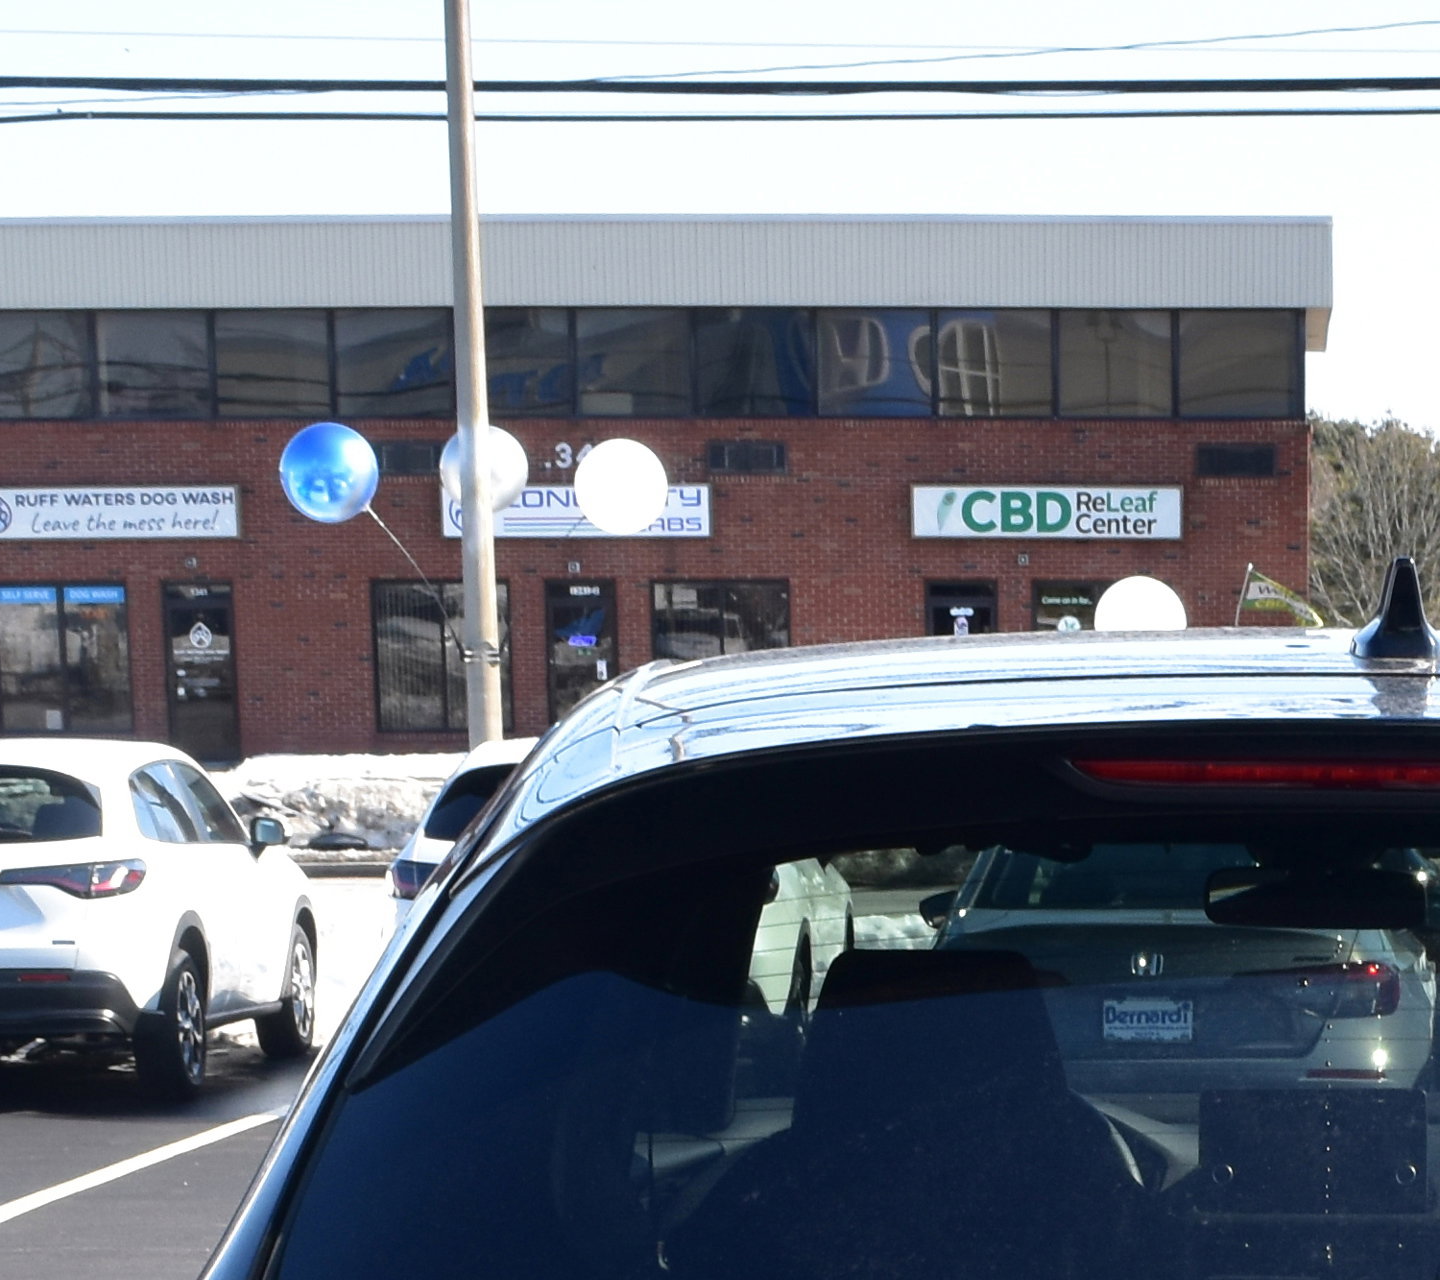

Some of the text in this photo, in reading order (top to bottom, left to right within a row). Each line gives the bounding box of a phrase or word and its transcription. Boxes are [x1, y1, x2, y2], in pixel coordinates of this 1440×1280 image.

[15, 491, 235, 507] RUFF WATERS DOG WASH
[1076, 491, 1158, 513] ReLeaf
[31, 509, 220, 534] Leave the mess here!
[961, 490, 1073, 533] CBD
[1075, 514, 1158, 535] Center
[1105, 1003, 1190, 1024] Bernardi
